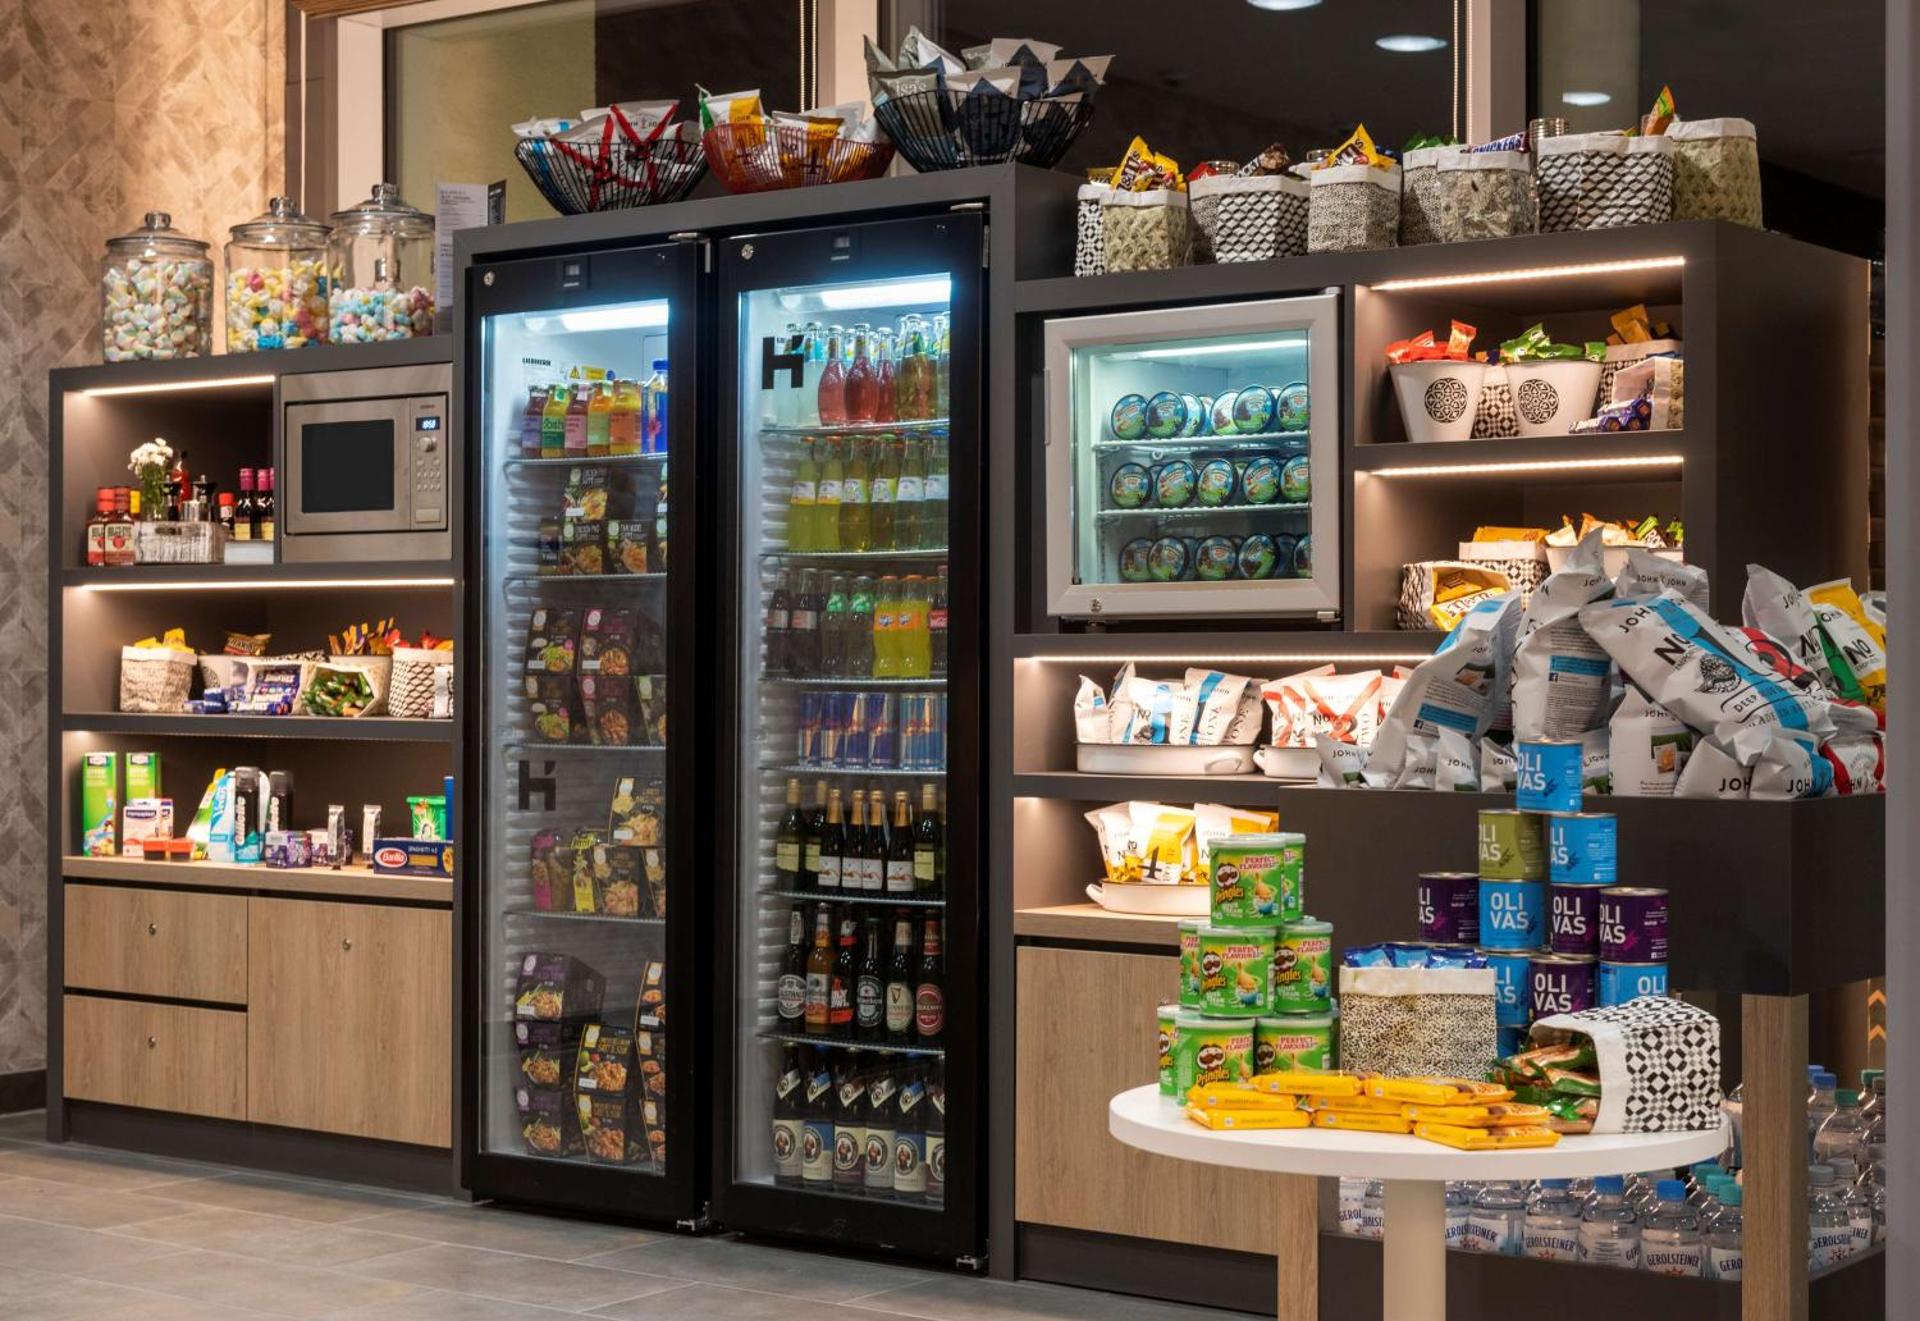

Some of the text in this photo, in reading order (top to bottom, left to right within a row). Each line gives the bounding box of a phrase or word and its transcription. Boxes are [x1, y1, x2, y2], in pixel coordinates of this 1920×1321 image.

[1719, 777, 1752, 792] JOH
[1490, 892, 1524, 911] OLI
[1553, 896, 1581, 916] OLI
[1490, 911, 1530, 930] VAS
[1552, 916, 1587, 935] VAS
[1534, 972, 1567, 993] OLI
[1637, 975, 1666, 995] OLI
[1533, 993, 1572, 1013] VAS
[1196, 1068, 1231, 1088] Pringles
[1646, 1252, 1700, 1267] GEROLSTEINER
[1719, 1257, 1742, 1272] GERO
